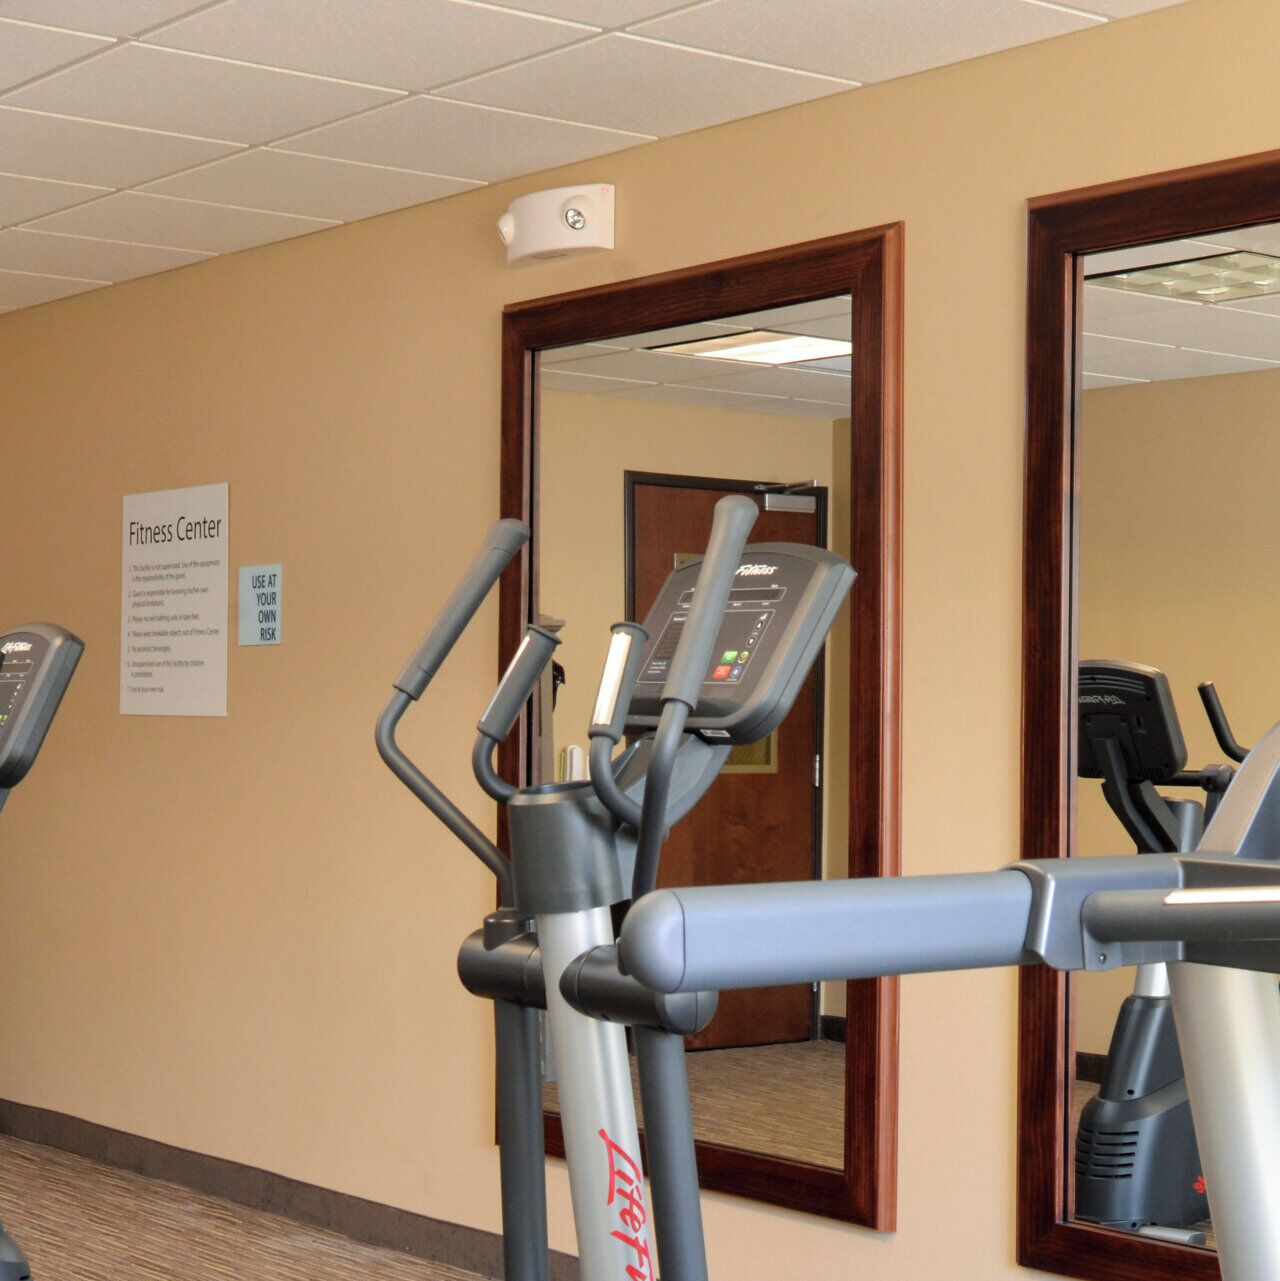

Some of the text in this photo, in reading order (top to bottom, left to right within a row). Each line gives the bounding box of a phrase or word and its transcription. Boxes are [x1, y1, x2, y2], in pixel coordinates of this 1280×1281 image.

[129, 516, 222, 546] Fitness Center
[252, 574, 277, 589] USE AT
[256, 592, 277, 606] YOUR
[258, 610, 277, 624] OWN
[260, 628, 277, 641] RISK
